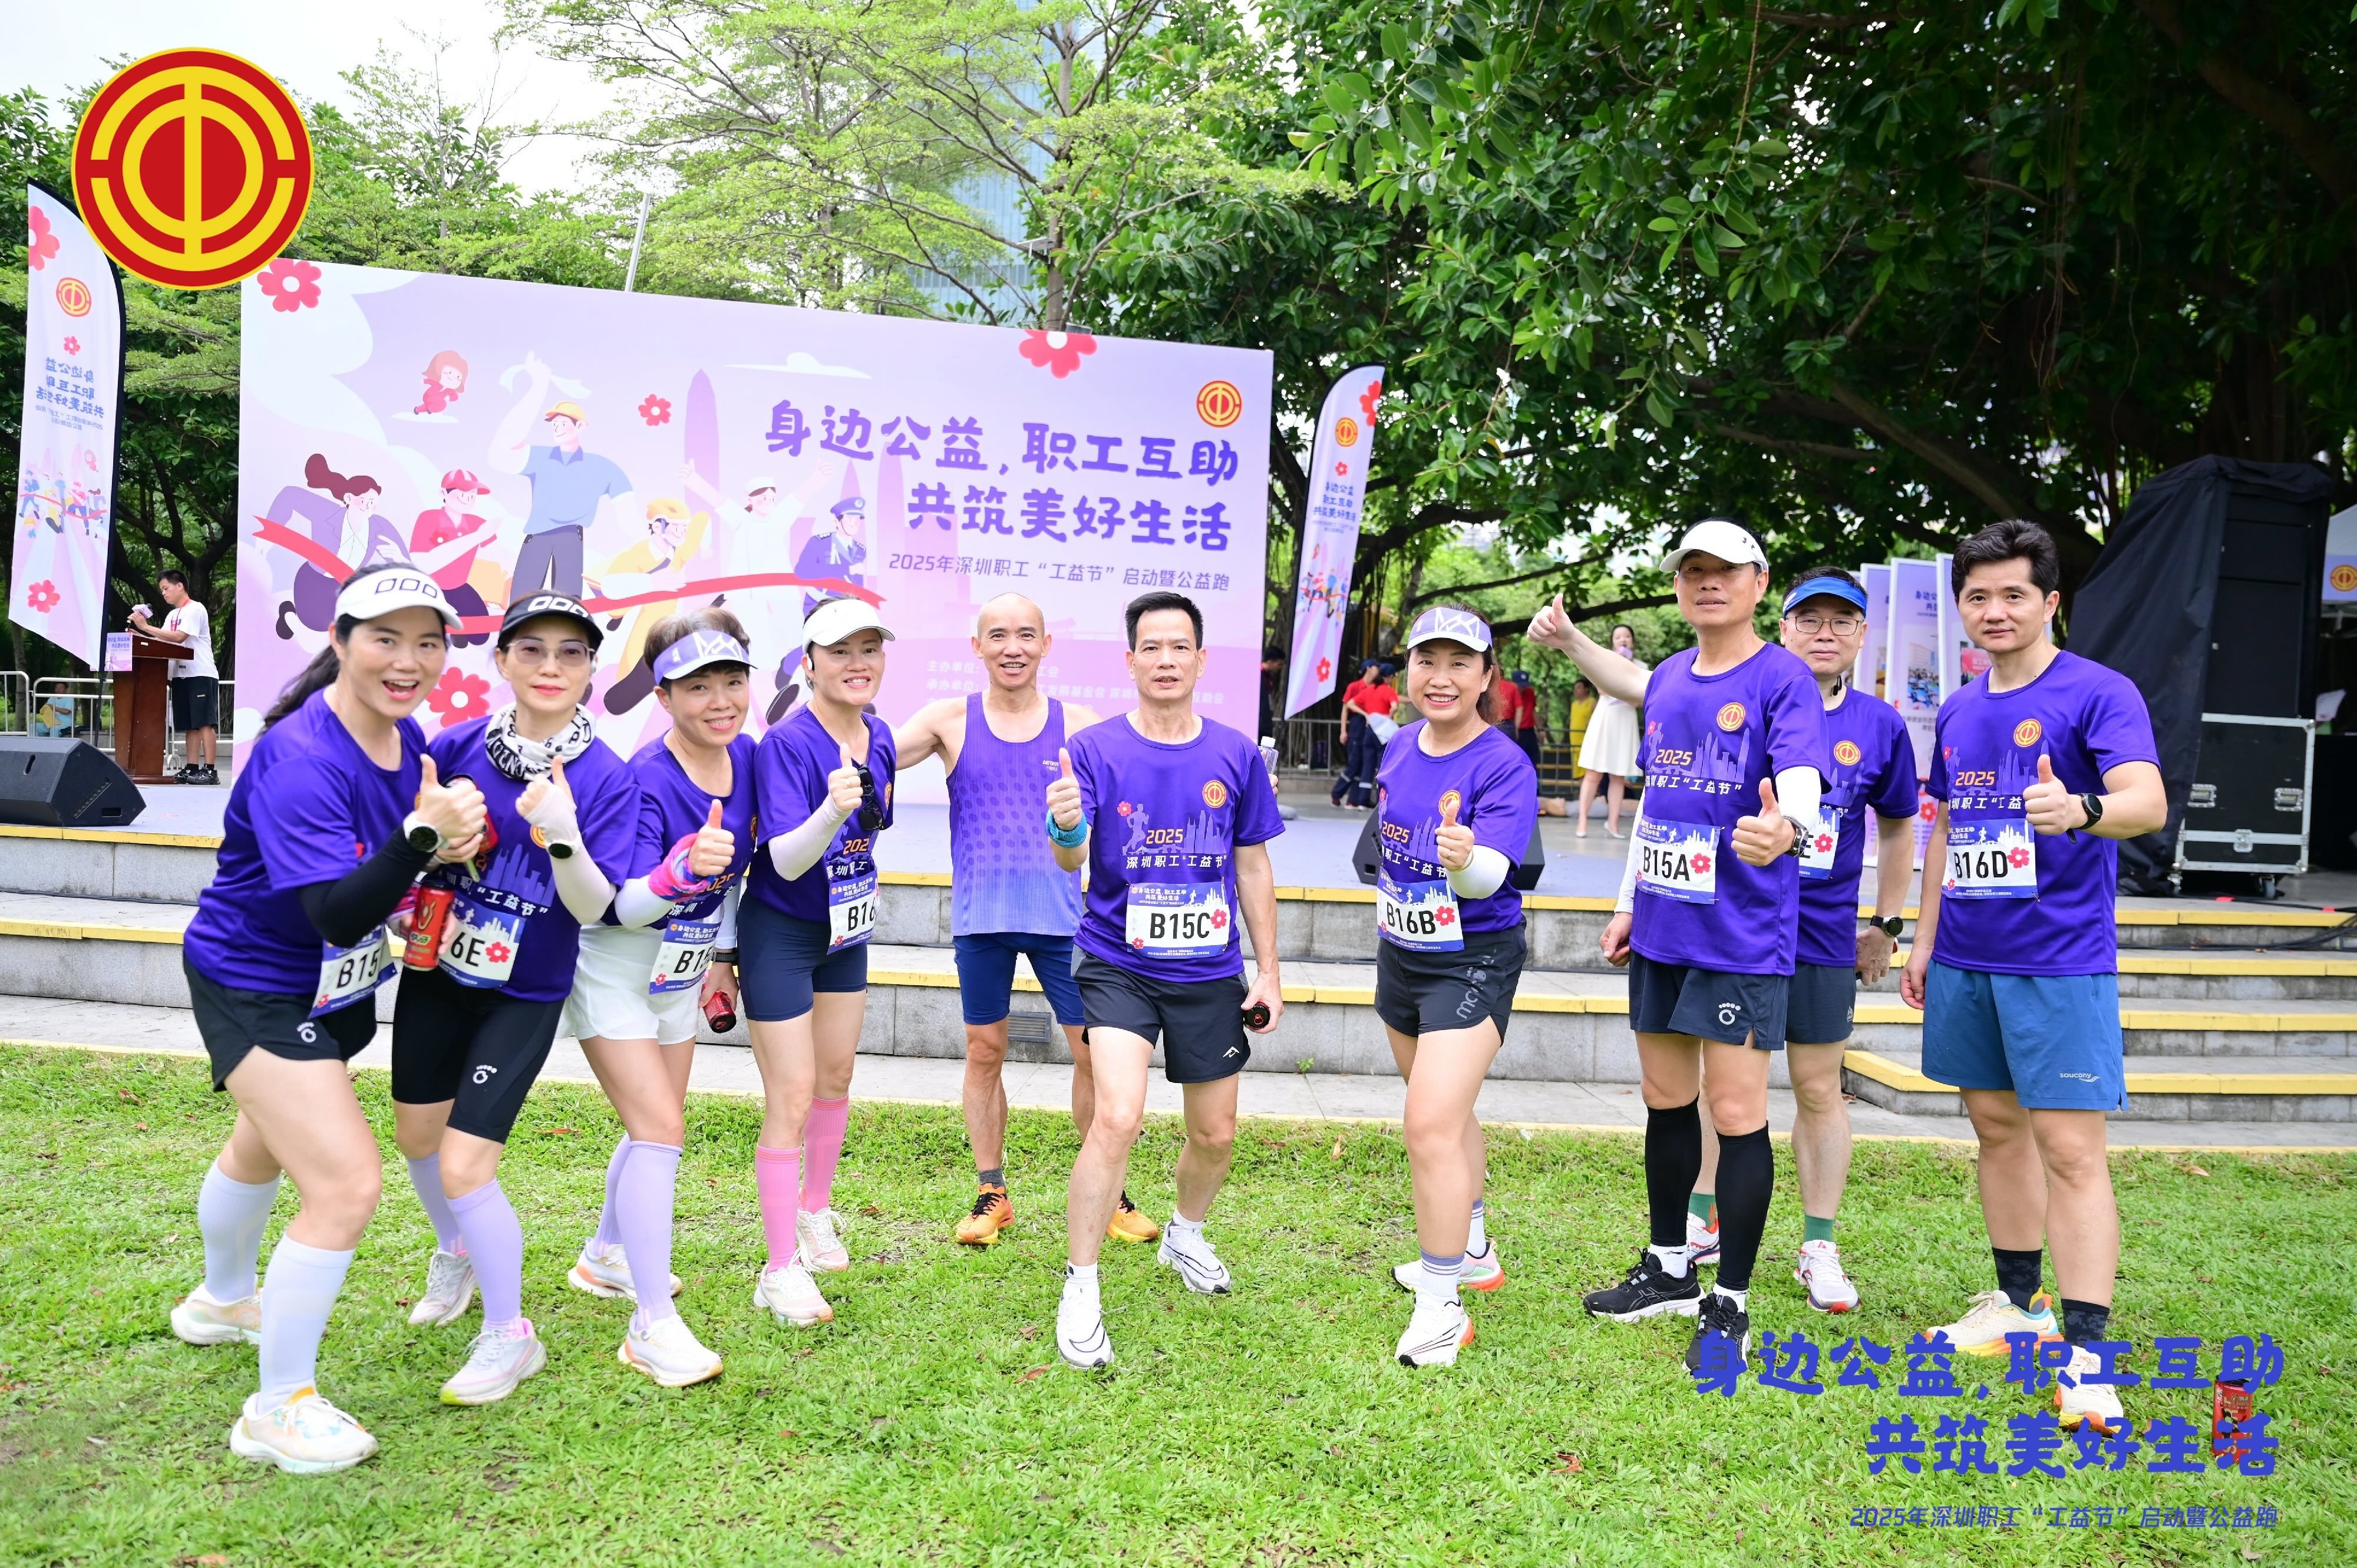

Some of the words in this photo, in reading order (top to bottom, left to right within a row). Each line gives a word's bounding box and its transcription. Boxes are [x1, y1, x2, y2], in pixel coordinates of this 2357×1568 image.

[907, 481, 1231, 552] 共筑美好生活
[1655, 749, 1693, 766] 2025
[1955, 771, 1996, 786] 2025
[1146, 828, 1184, 844] 2025
[1382, 820, 1410, 843] 2025
[1643, 846, 1691, 882] B15A
[1953, 850, 2008, 879] B16D
[1150, 912, 1211, 939] B15C
[1387, 901, 1436, 935] B16B
